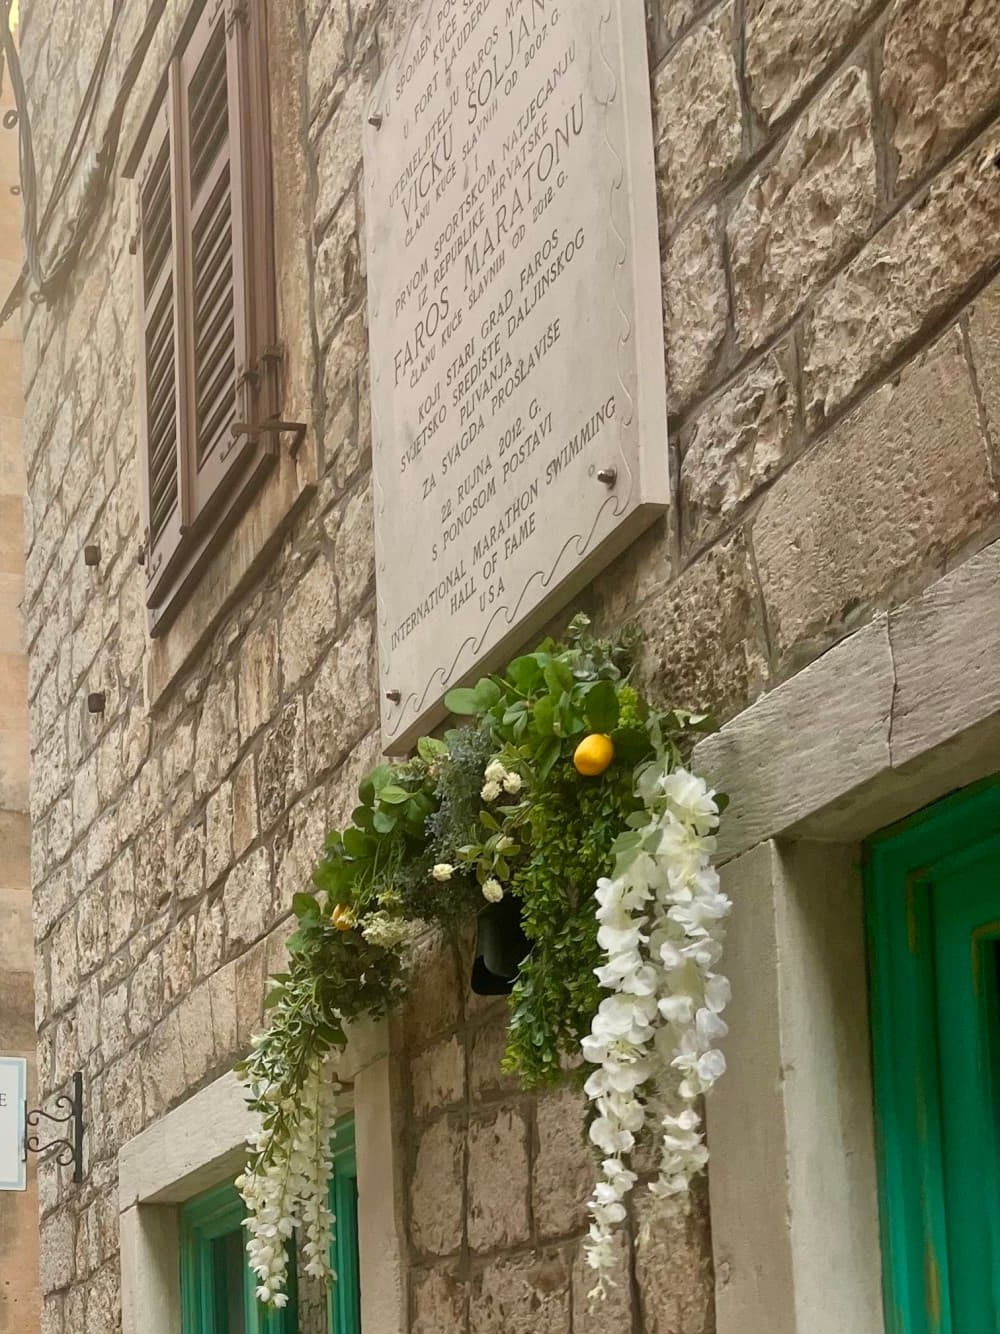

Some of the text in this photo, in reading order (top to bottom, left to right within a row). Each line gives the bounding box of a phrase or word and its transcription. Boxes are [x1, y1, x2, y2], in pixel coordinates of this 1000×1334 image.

[388, 86, 460, 208] UTEMELJITELJU
[465, 25, 499, 86] FAROS
[395, 30, 432, 101] SPOMEN
[437, 0, 457, 30] PO
[403, 124, 409, 139] U
[413, 72, 439, 122] FORT
[393, 93, 585, 388] FAROS MARATONU
[394, 39, 577, 319] PRVOM SPORTSKOM NATJECANJU
[401, 121, 454, 222] VICKU
[405, 204, 431, 248] ČLANU
[435, 160, 457, 204] KUĆE
[462, 98, 499, 161] SLAVNIH
[504, 70, 518, 97] OD
[418, 112, 549, 312] IZ REPUBLIKE HRVATSKE
[400, 227, 585, 474] SVJETSKO SREDIŠTE DALJINSKOG
[410, 170, 569, 389] ČLANU KUĆE SLAVNIH OD 2012. G.
[418, 228, 559, 425] KOJI STARI GRAD FAROS
[422, 318, 562, 501] ZA SVAGDA PROSLAVIŠE
[457, 454, 493, 505] RUJNA
[498, 416, 526, 458] 2012.
[528, 398, 542, 421] G.
[460, 351, 513, 427] PLIVANJA
[390, 395, 617, 652] INTERNATIONAL MARATHON SWIMMING
[431, 411, 553, 562] S PONOSOM POSTAVI
[450, 511, 537, 616] HALL OF FAME
[479, 576, 506, 613] USA
